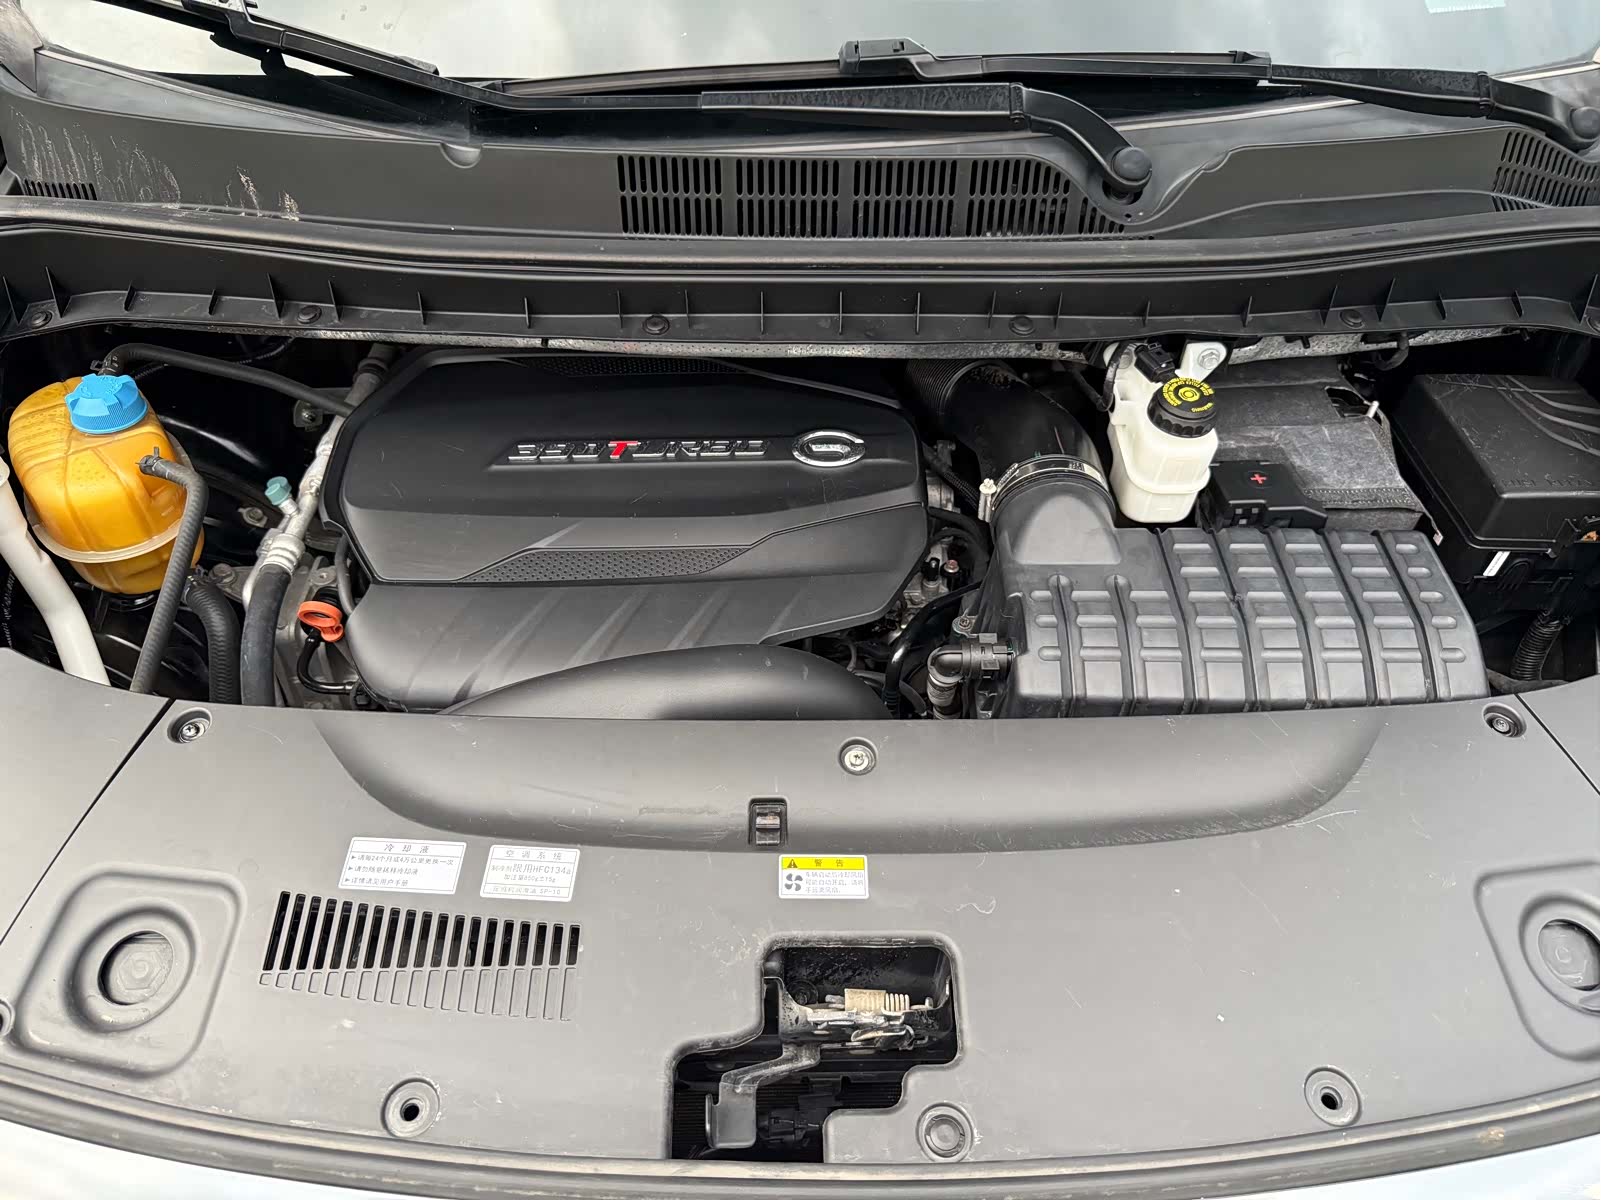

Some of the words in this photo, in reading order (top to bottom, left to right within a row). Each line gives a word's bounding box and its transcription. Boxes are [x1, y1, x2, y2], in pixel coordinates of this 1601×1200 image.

[384, 843, 430, 854] 冷却液
[504, 849, 562, 861] 空调系统
[814, 858, 844, 867] 警告
